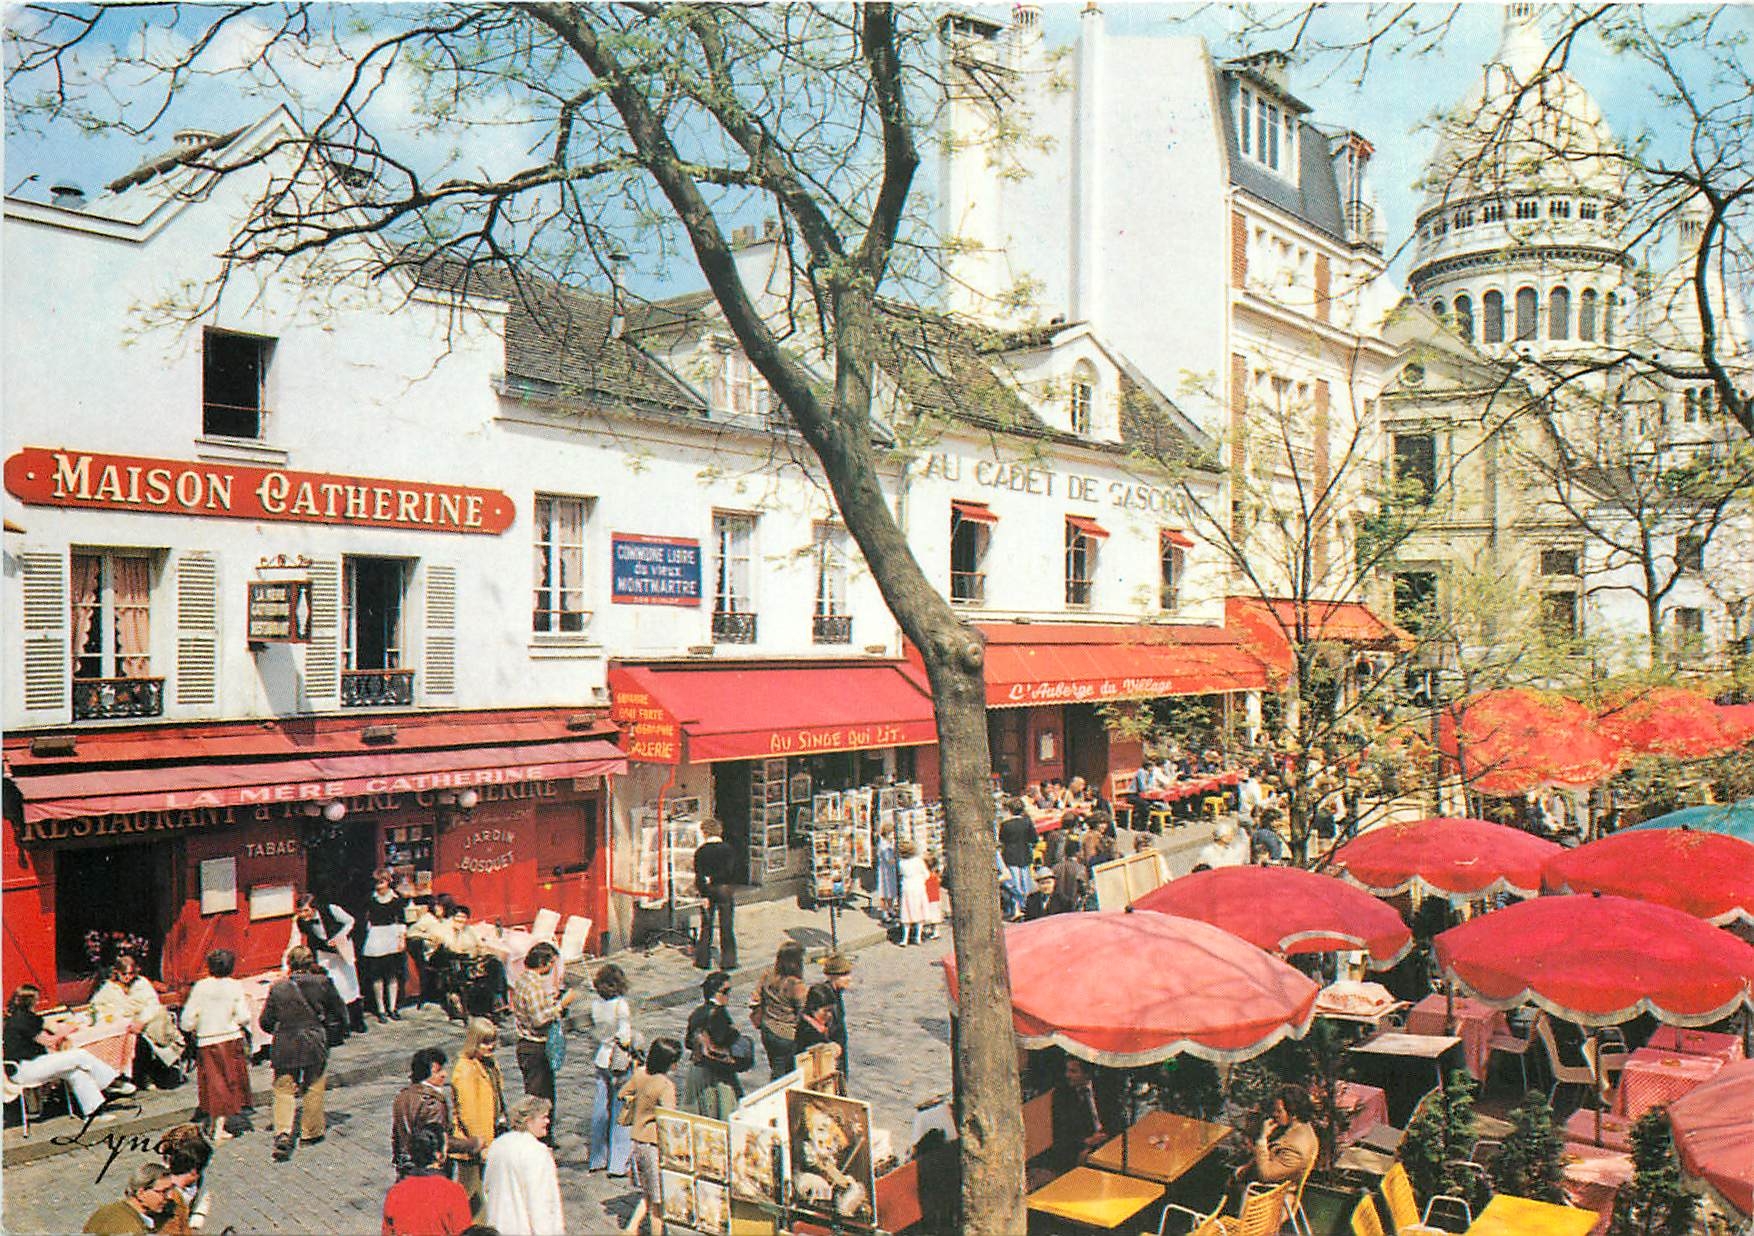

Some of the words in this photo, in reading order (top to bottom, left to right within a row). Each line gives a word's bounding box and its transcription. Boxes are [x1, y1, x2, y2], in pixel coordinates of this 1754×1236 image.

[923, 452, 959, 481] AU
[974, 459, 1056, 497] CADET
[1068, 474, 1099, 502] DE
[52, 453, 234, 511] MAISON
[256, 472, 483, 527] CATHERINE
[667, 549, 696, 565] LIBRE
[617, 577, 697, 595] MONTMARTRE
[1009, 681, 1094, 700] L'Auberge
[1100, 680, 1117, 695] du
[1123, 678, 1173, 695] Village
[770, 733, 792, 752] AU
[799, 731, 841, 750] SINGE
[166, 791, 220, 808] LA
[366, 767, 543, 792] CATHERINE
[246, 839, 298, 858] TABAC
[463, 829, 515, 850] JARDIN
[461, 850, 514, 874] BOSQUET
